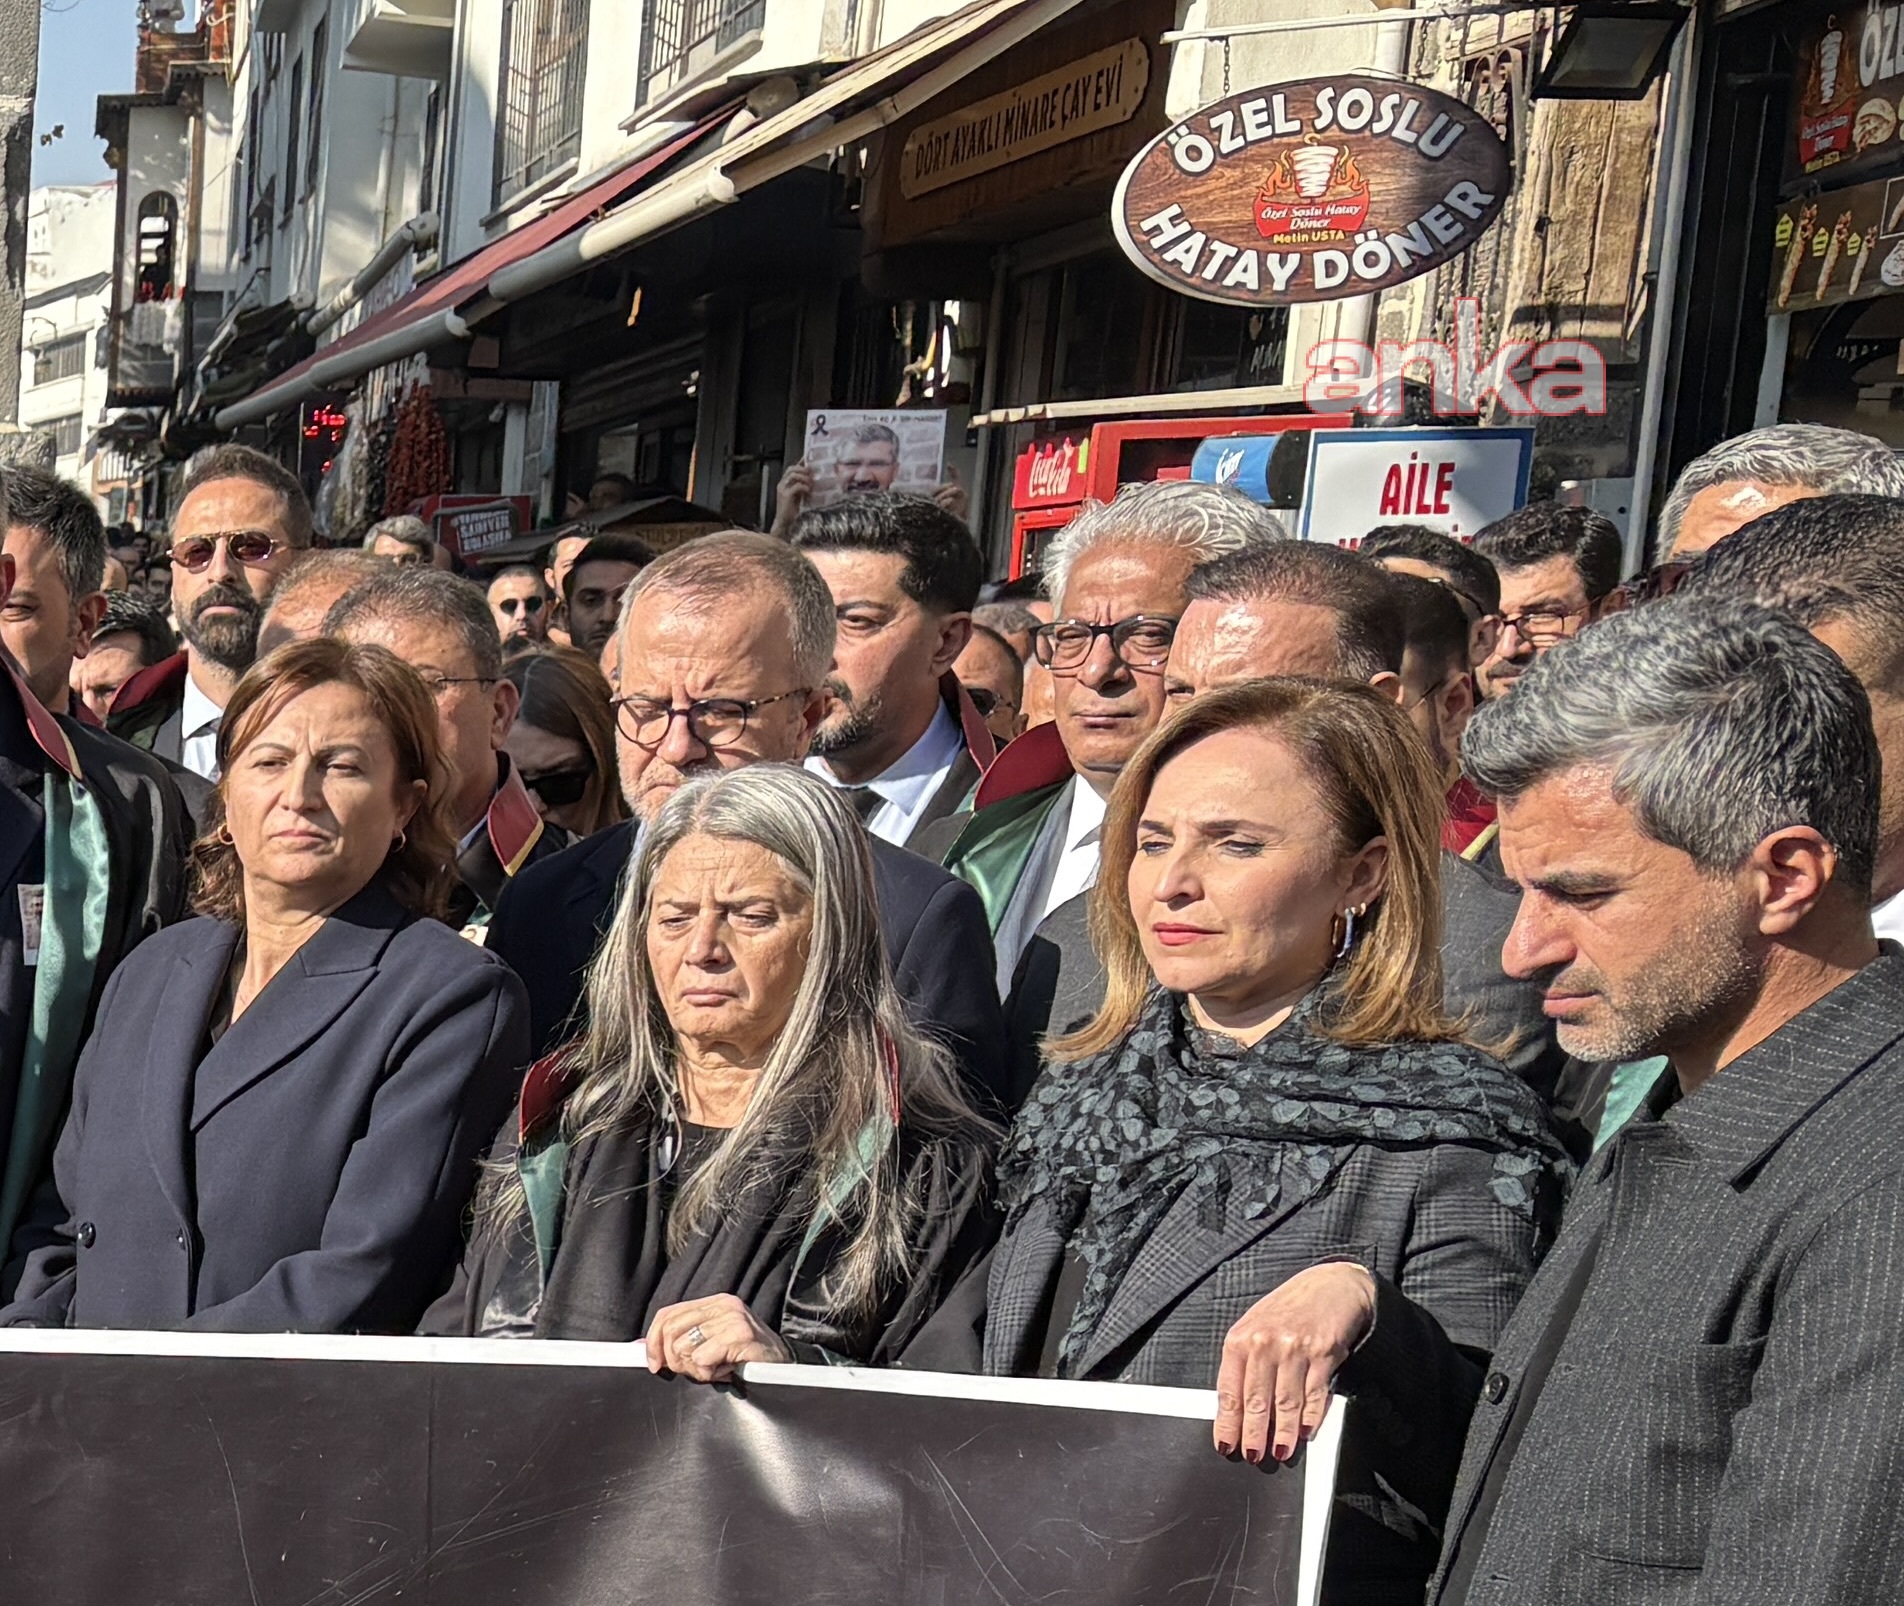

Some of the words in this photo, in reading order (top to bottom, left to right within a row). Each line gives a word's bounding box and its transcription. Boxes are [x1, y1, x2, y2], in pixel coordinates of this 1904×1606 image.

[914, 130, 950, 180] DÖRT
[950, 110, 1003, 166] AYAKLI
[1003, 96, 1059, 147] MİNARE
[1061, 74, 1092, 131] ÇAY
[1093, 53, 1124, 113] EVİ
[1166, 93, 1302, 173] ÖZEL
[1313, 86, 1467, 159] SOSLU
[1138, 202, 1302, 291] HATAY
[1313, 180, 1495, 291] DÖNER
[1290, 217, 1331, 230] Döner
[1311, 229, 1345, 242] USTA
[1379, 451, 1456, 516] AİLE
